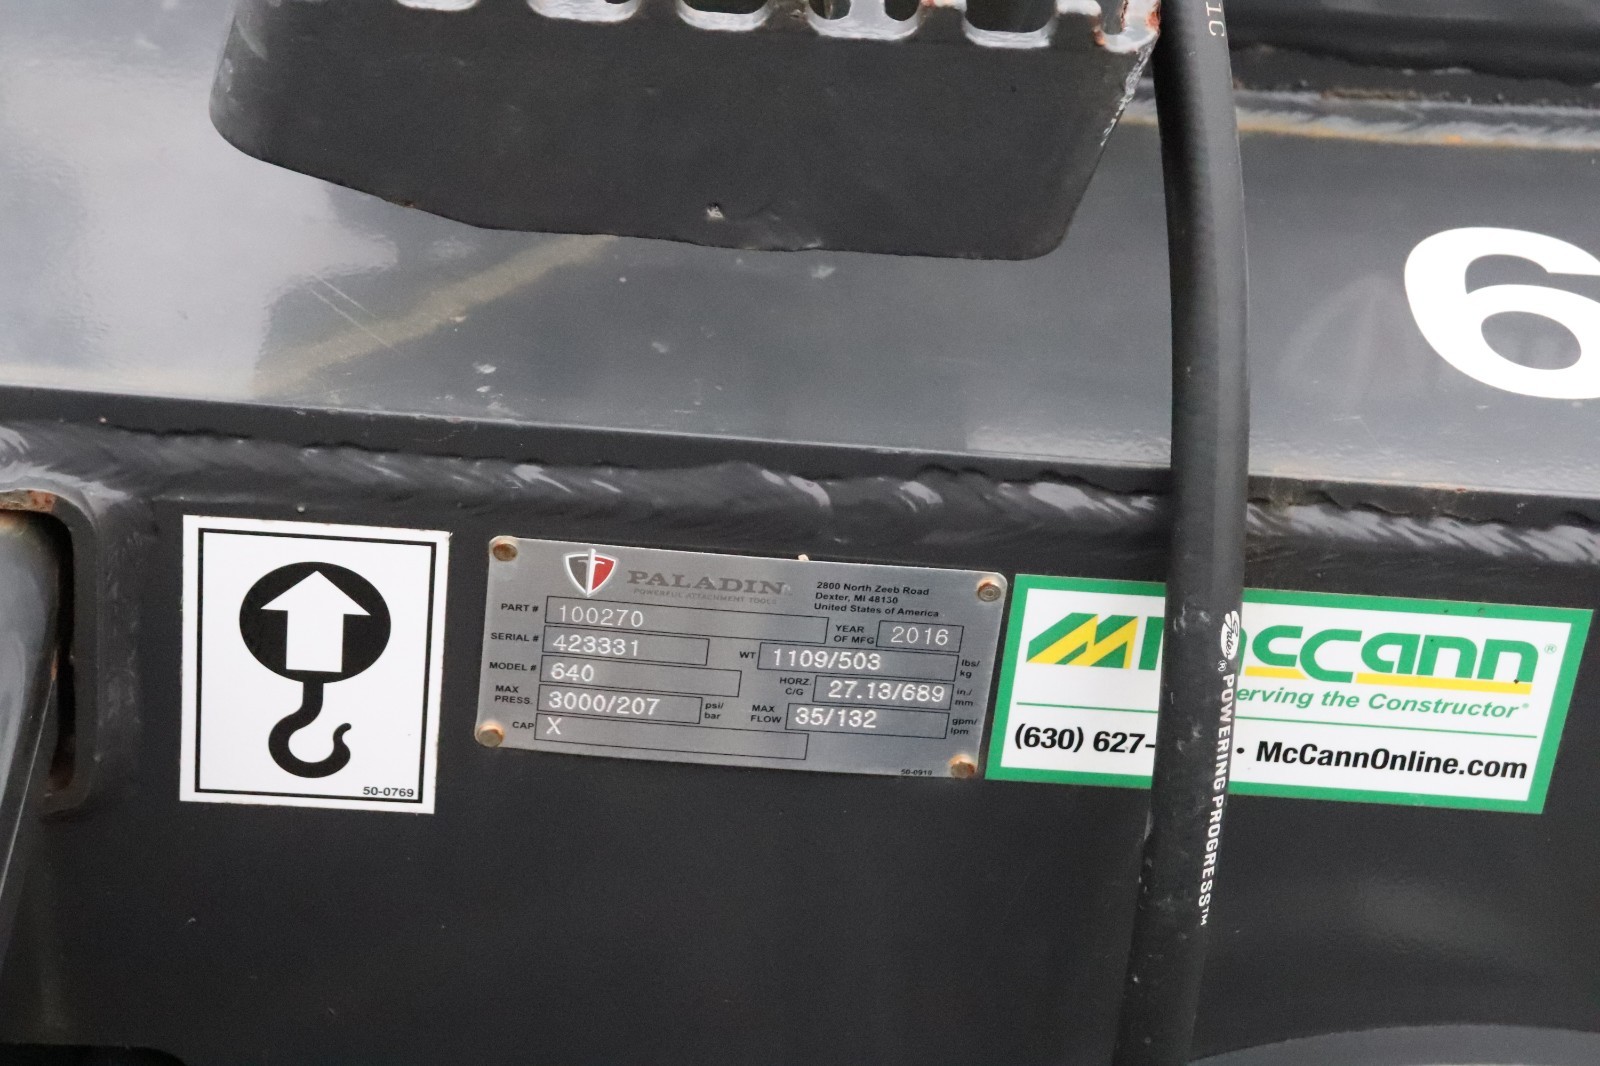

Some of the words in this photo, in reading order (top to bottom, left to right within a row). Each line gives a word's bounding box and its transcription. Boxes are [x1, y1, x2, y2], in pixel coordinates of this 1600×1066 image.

[1404, 226, 1600, 399] 6
[627, 570, 785, 595] PALADIN
[816, 582, 841, 591] 2800
[843, 583, 872, 593] North
[874, 585, 900, 594] Zeeb
[902, 587, 929, 596] Road
[633, 588, 682, 599] POWERFUL
[685, 593, 744, 603] ATTACHMENT
[815, 592, 851, 603] Dexter,
[853, 594, 867, 602] MI
[868, 595, 899, 604] 48130
[501, 603, 529, 612] PART
[532, 605, 539, 613] #
[814, 603, 847, 612] United
[850, 605, 882, 614] States
[884, 606, 896, 615] of
[897, 607, 939, 618] America
[559, 605, 644, 628] 100270
[836, 624, 864, 633] YEAR
[490, 633, 529, 642] SERIAL
[834, 635, 848, 643] OF
[850, 636, 875, 645] MFG
[890, 626, 949, 646] 2016
[553, 634, 639, 656] 423331
[739, 650, 757, 659] WT
[773, 648, 882, 671] 1109/503
[489, 662, 527, 671] MODEL
[530, 664, 537, 672] #
[550, 662, 595, 682] 640
[960, 669, 972, 679] kg
[495, 685, 519, 693] MAX
[785, 687, 804, 696] C/G
[828, 680, 945, 703] 27.13/689
[548, 691, 661, 715] 3000/207
[955, 699, 974, 707] mm
[1236, 686, 1315, 709] erving
[1319, 690, 1360, 708] the
[705, 702, 724, 711] psi/
[752, 704, 775, 713] MAX
[704, 712, 721, 720] bar
[750, 714, 782, 724] FLOW
[795, 707, 877, 729] 35/132
[512, 721, 534, 729] CAP
[546, 716, 561, 735] X
[1212, 674, 1235, 791] POWERING
[1013, 723, 1084, 752] (630)
[1256, 740, 1528, 779] McCannOnline.com
[363, 786, 414, 797] 50-0769
